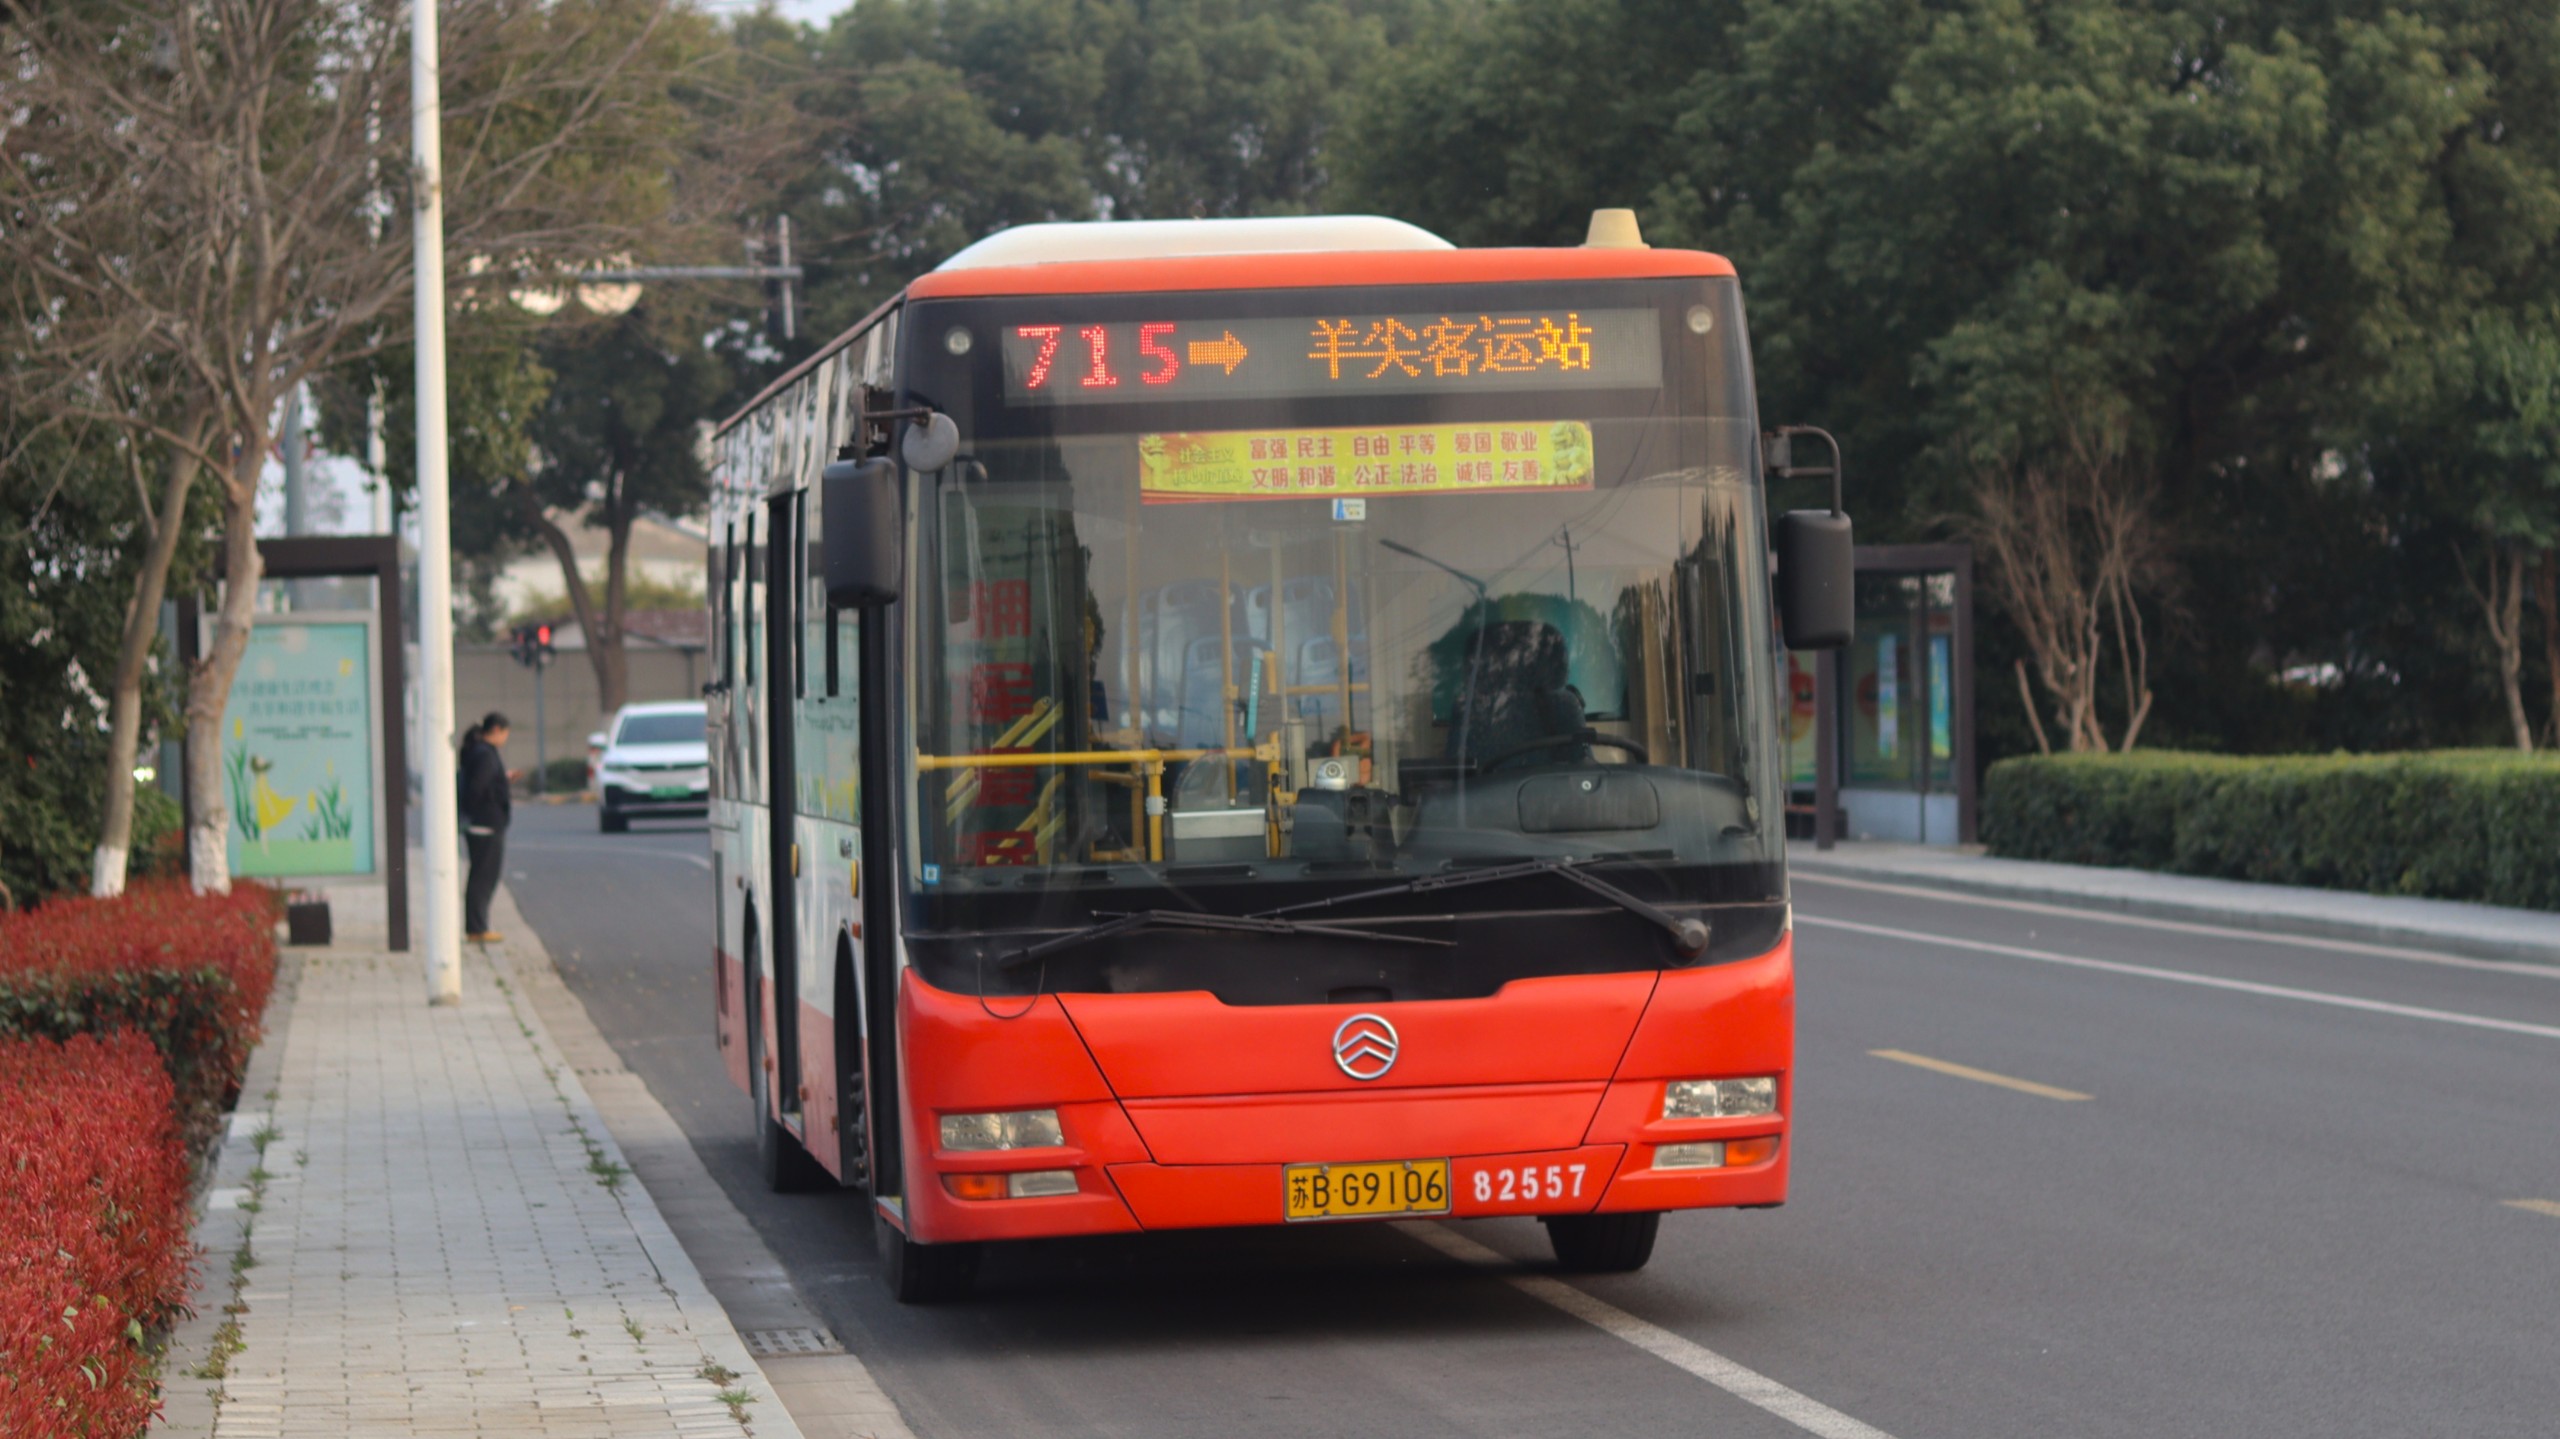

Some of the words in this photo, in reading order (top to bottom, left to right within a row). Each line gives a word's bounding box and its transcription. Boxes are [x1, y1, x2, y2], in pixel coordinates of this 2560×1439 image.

[1018, 323, 1180, 388] 715
[1308, 313, 1592, 379] 羊尖客运站
[1473, 1164, 1587, 1202] 82557
